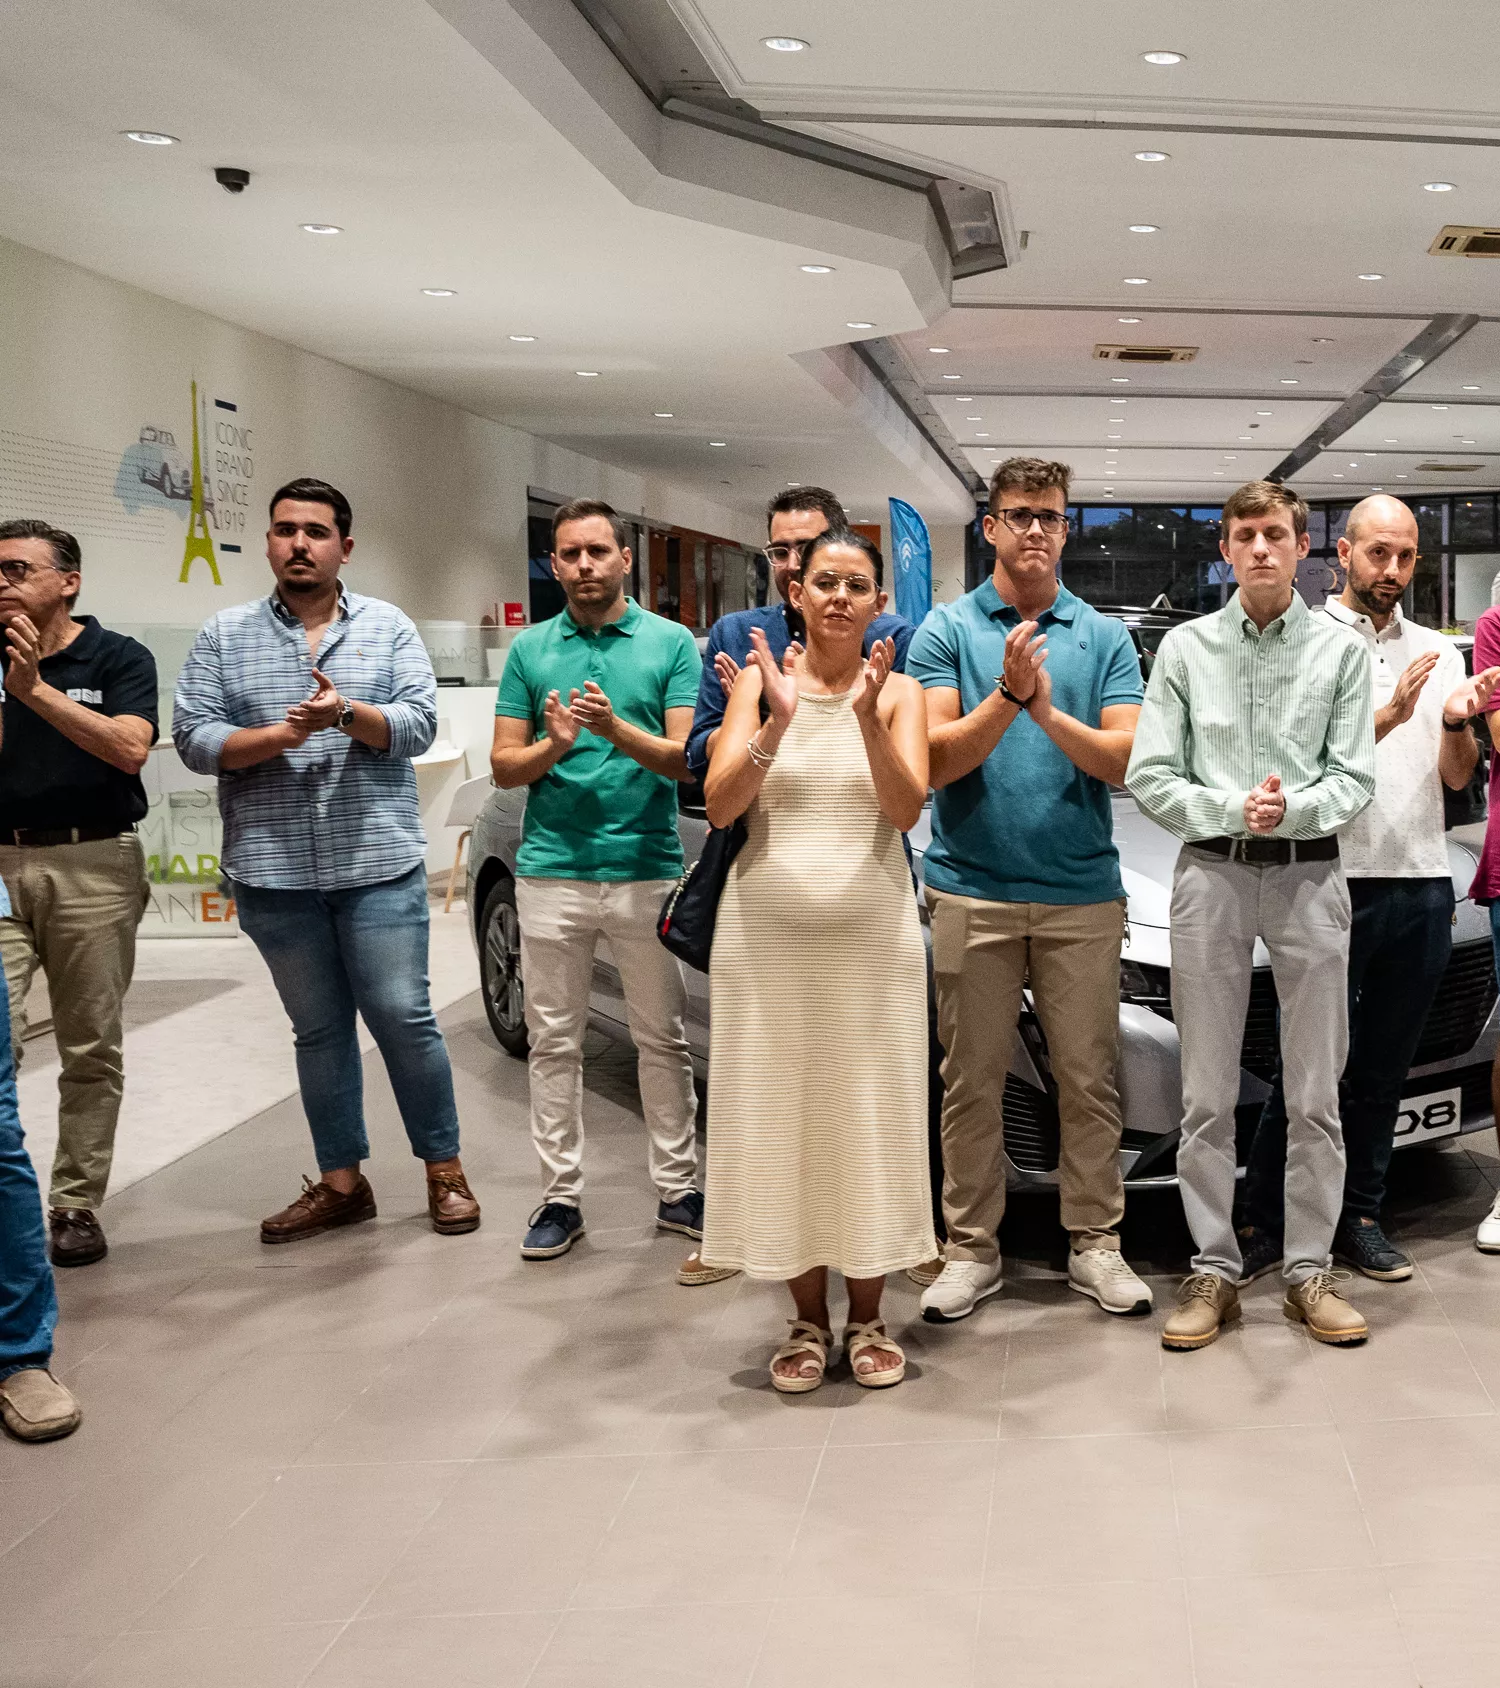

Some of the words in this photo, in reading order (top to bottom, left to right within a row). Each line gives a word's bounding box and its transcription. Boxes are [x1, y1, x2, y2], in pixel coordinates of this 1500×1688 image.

[215, 421, 254, 452] ICONIC
[215, 450, 254, 479] BRAND
[217, 479, 249, 507] SINCE
[218, 509, 246, 534] 1919
